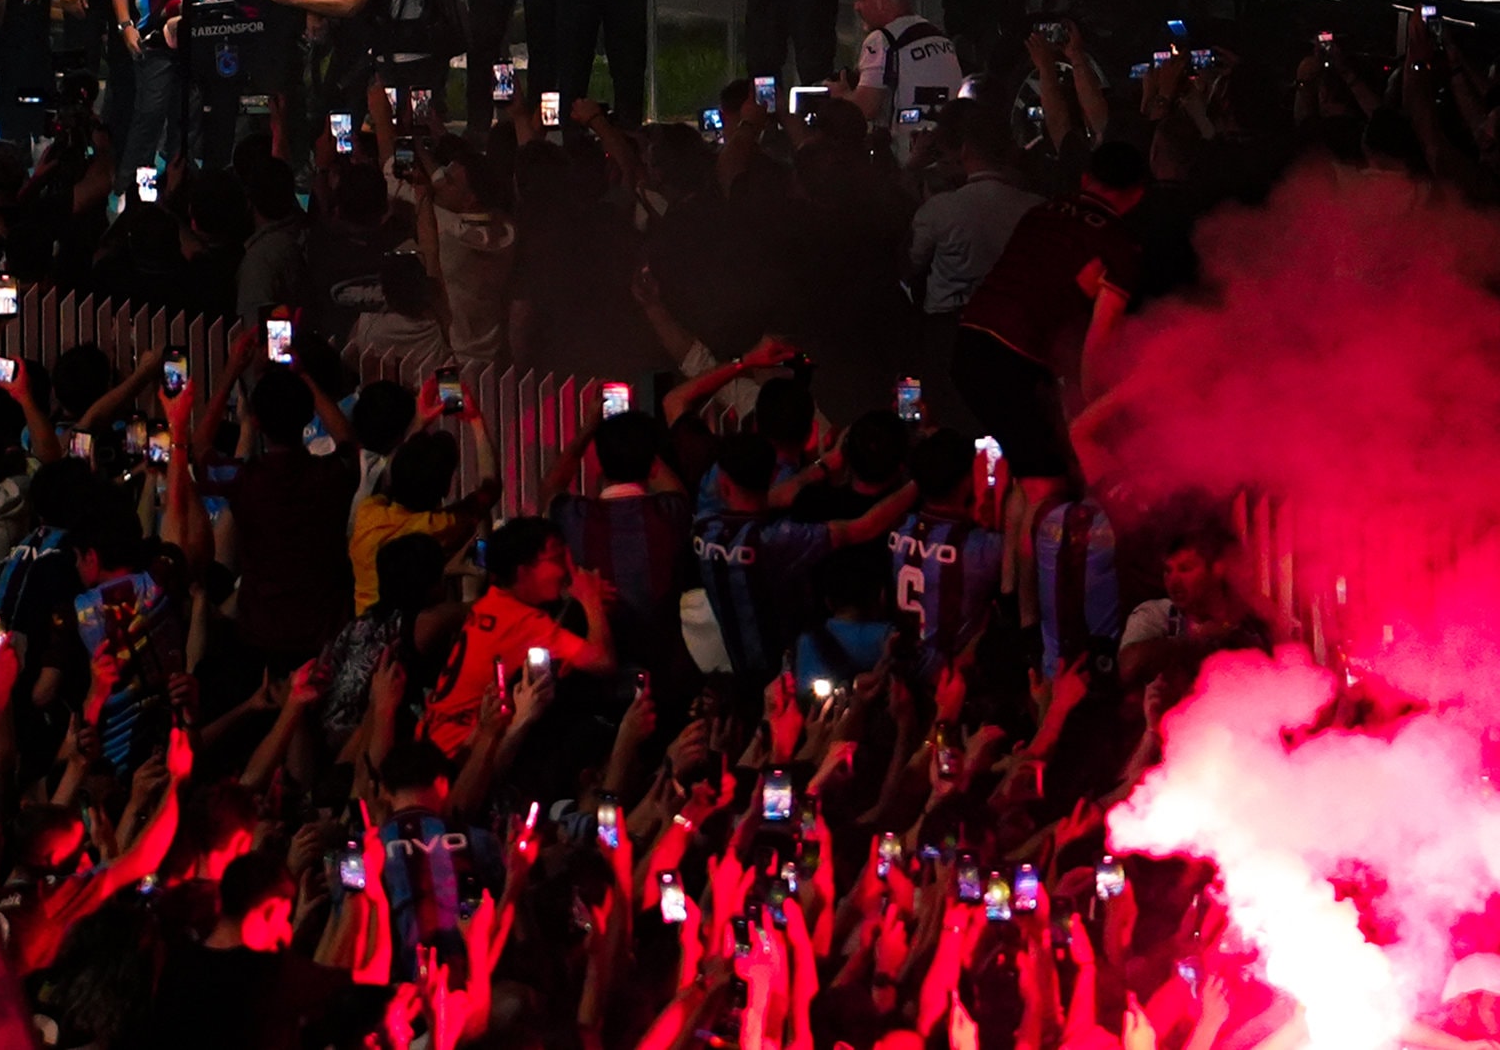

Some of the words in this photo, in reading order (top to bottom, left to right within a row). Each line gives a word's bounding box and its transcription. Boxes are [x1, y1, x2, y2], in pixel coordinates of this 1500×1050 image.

[190, 21, 265, 37] RABZONSPOR
[693, 535, 756, 566] onvo
[887, 531, 957, 564] onvo
[385, 832, 469, 859] nvo
